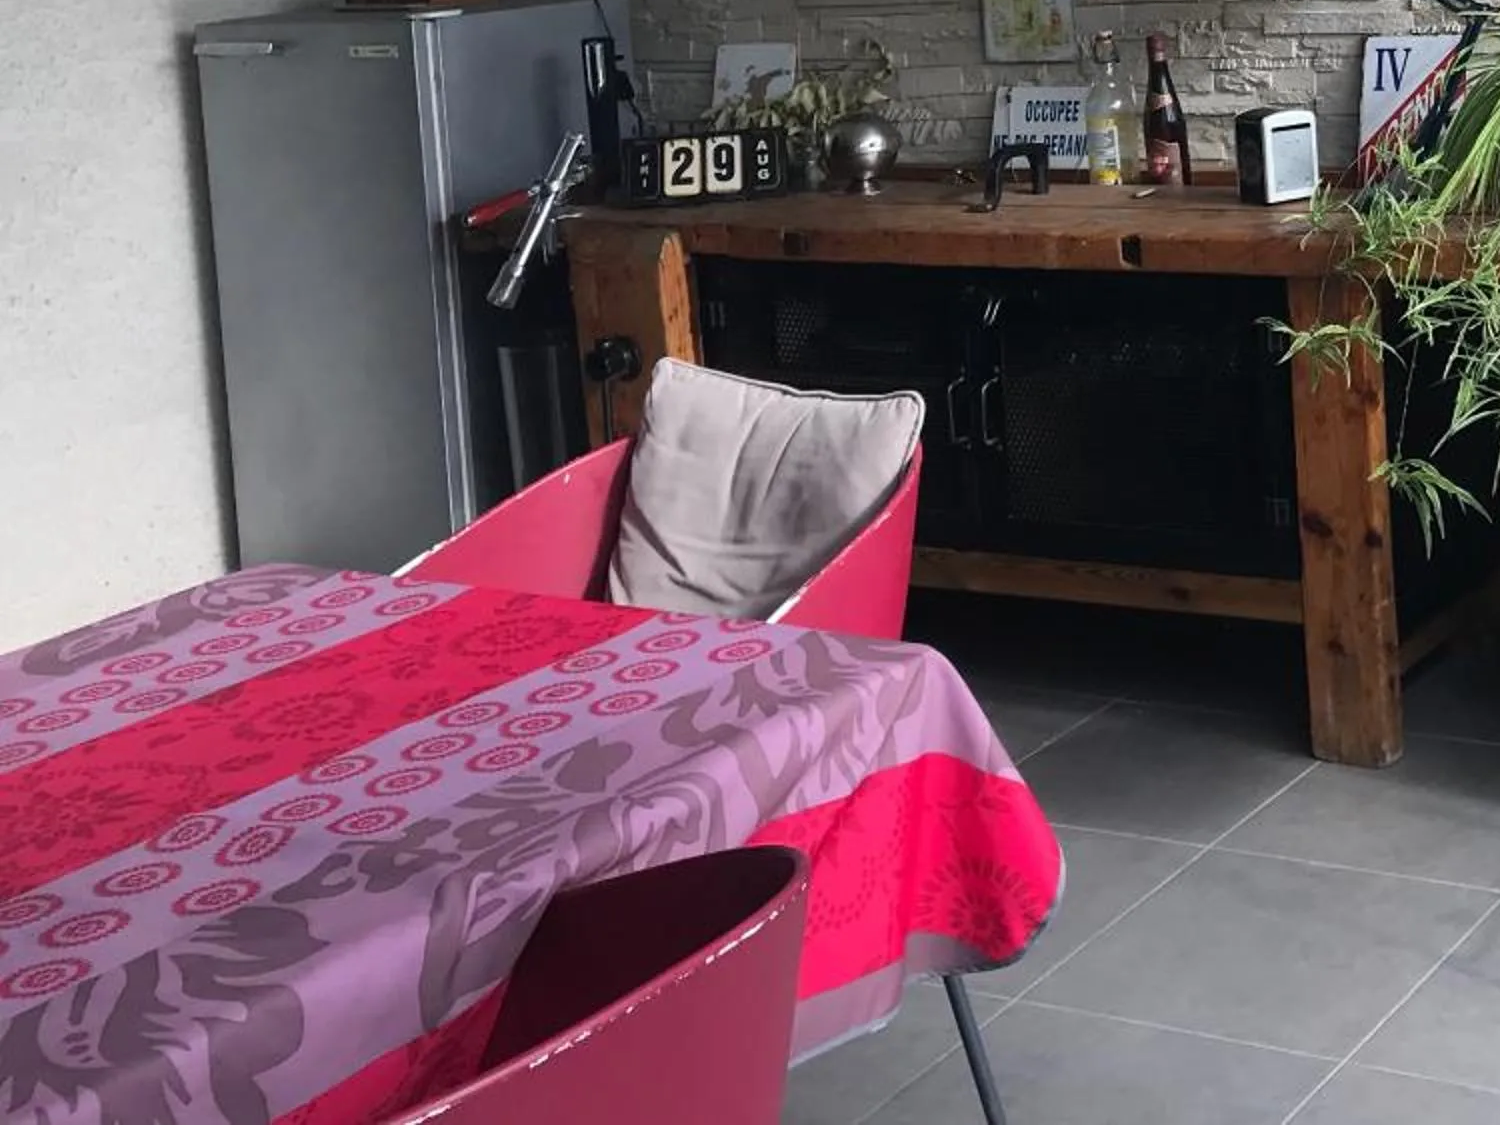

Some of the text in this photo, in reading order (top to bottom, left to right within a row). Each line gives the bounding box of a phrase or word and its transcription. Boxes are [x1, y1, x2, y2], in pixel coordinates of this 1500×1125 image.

[1373, 48, 1412, 92] IV
[1025, 100, 1081, 123] OCCUPEE
[671, 143, 735, 186] 29
[755, 138, 772, 181] AUG
